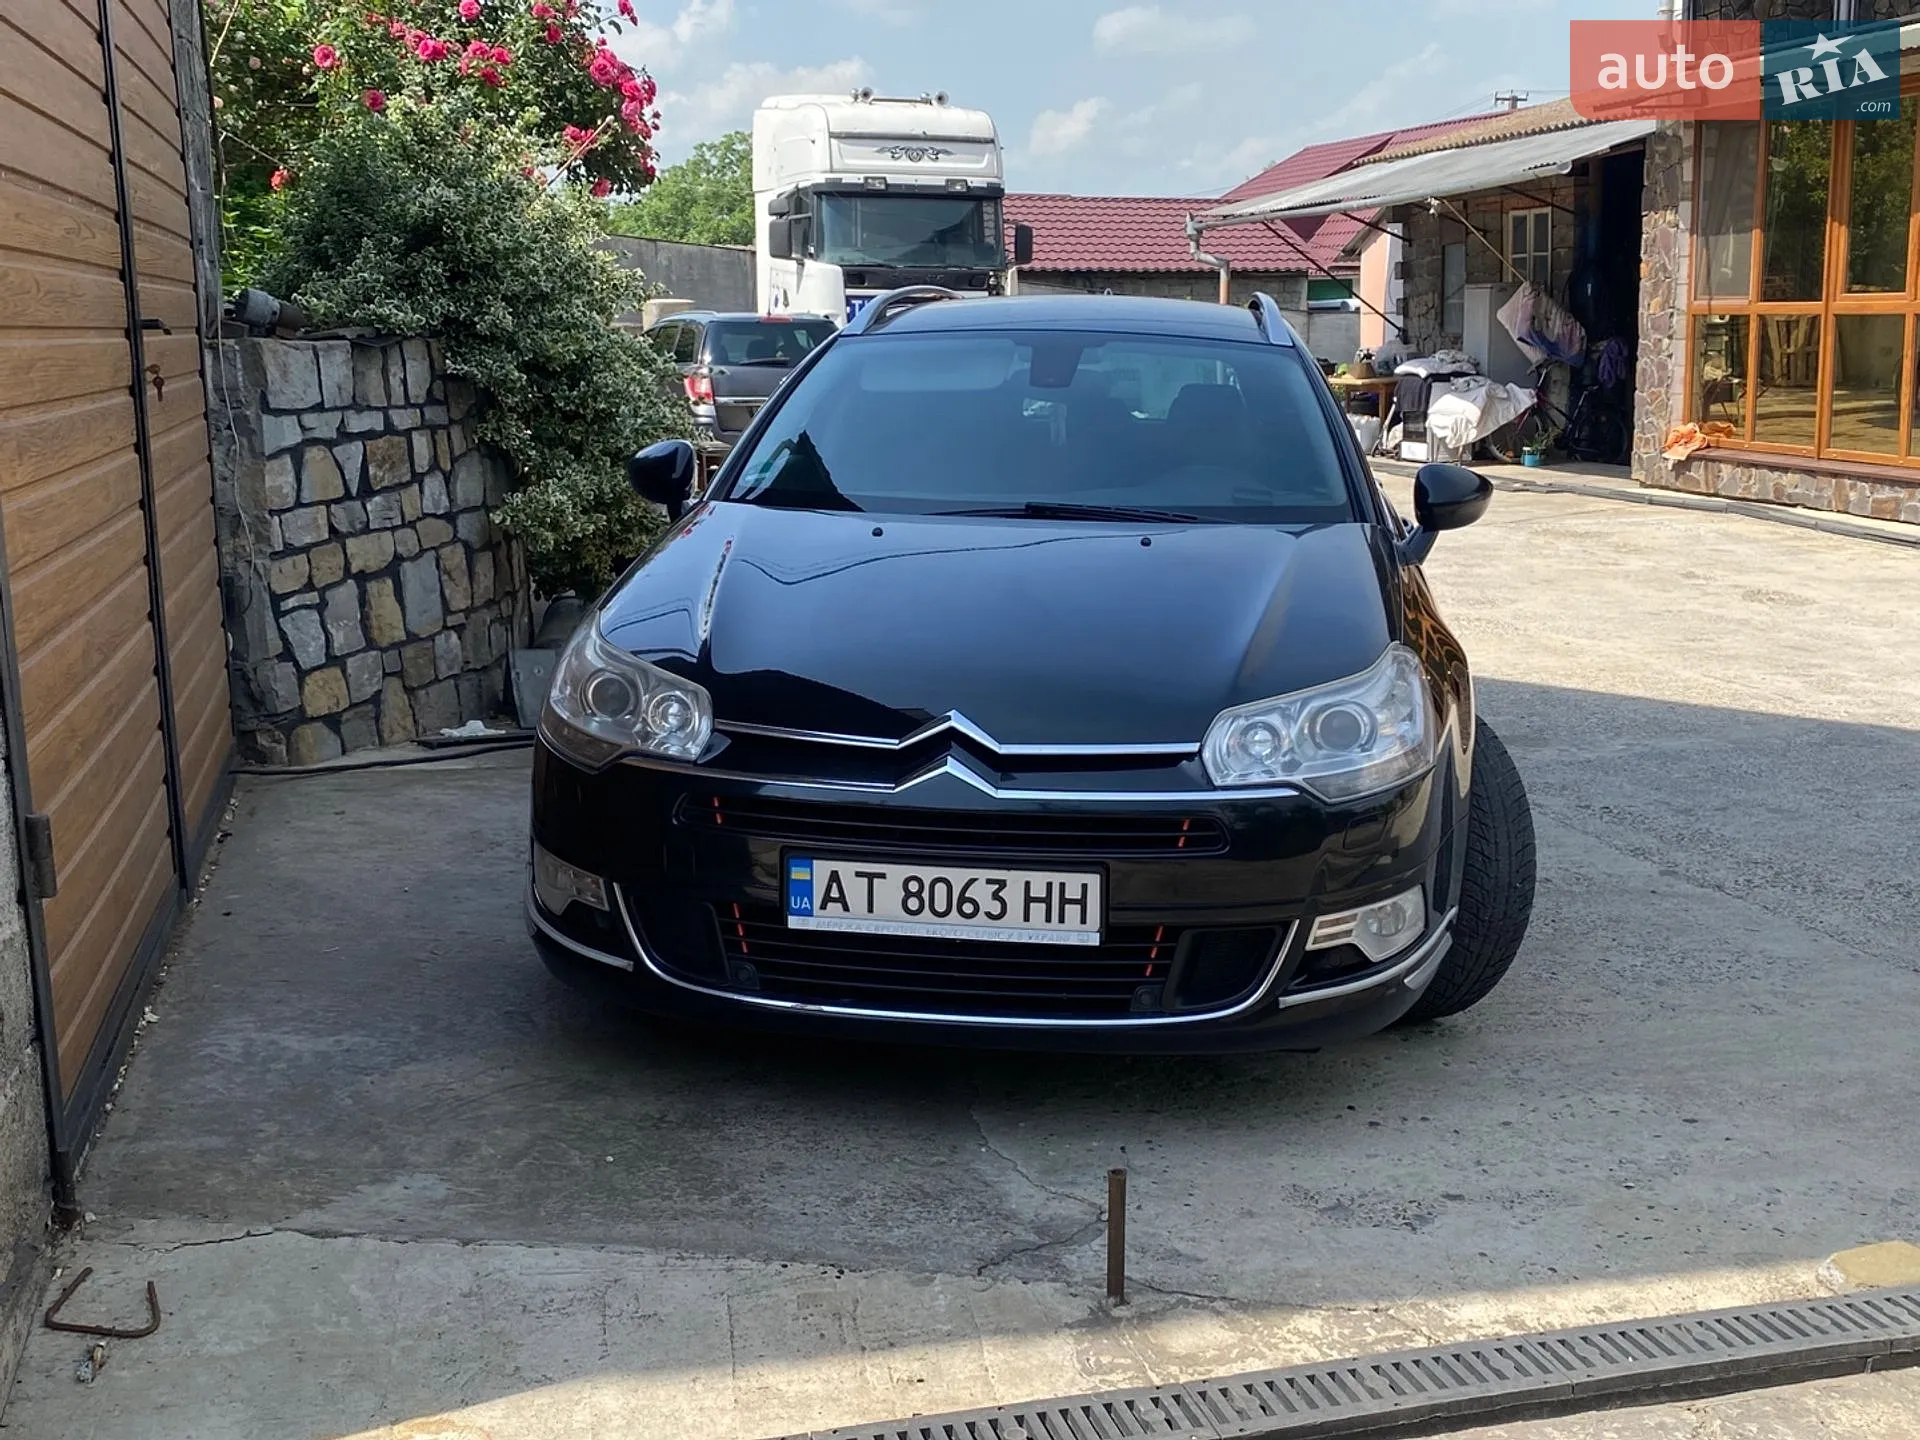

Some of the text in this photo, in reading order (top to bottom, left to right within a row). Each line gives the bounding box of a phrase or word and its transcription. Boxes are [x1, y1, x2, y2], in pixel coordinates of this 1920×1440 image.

[790, 895, 812, 910] UA
[819, 869, 1089, 925] AT 8063 HH
